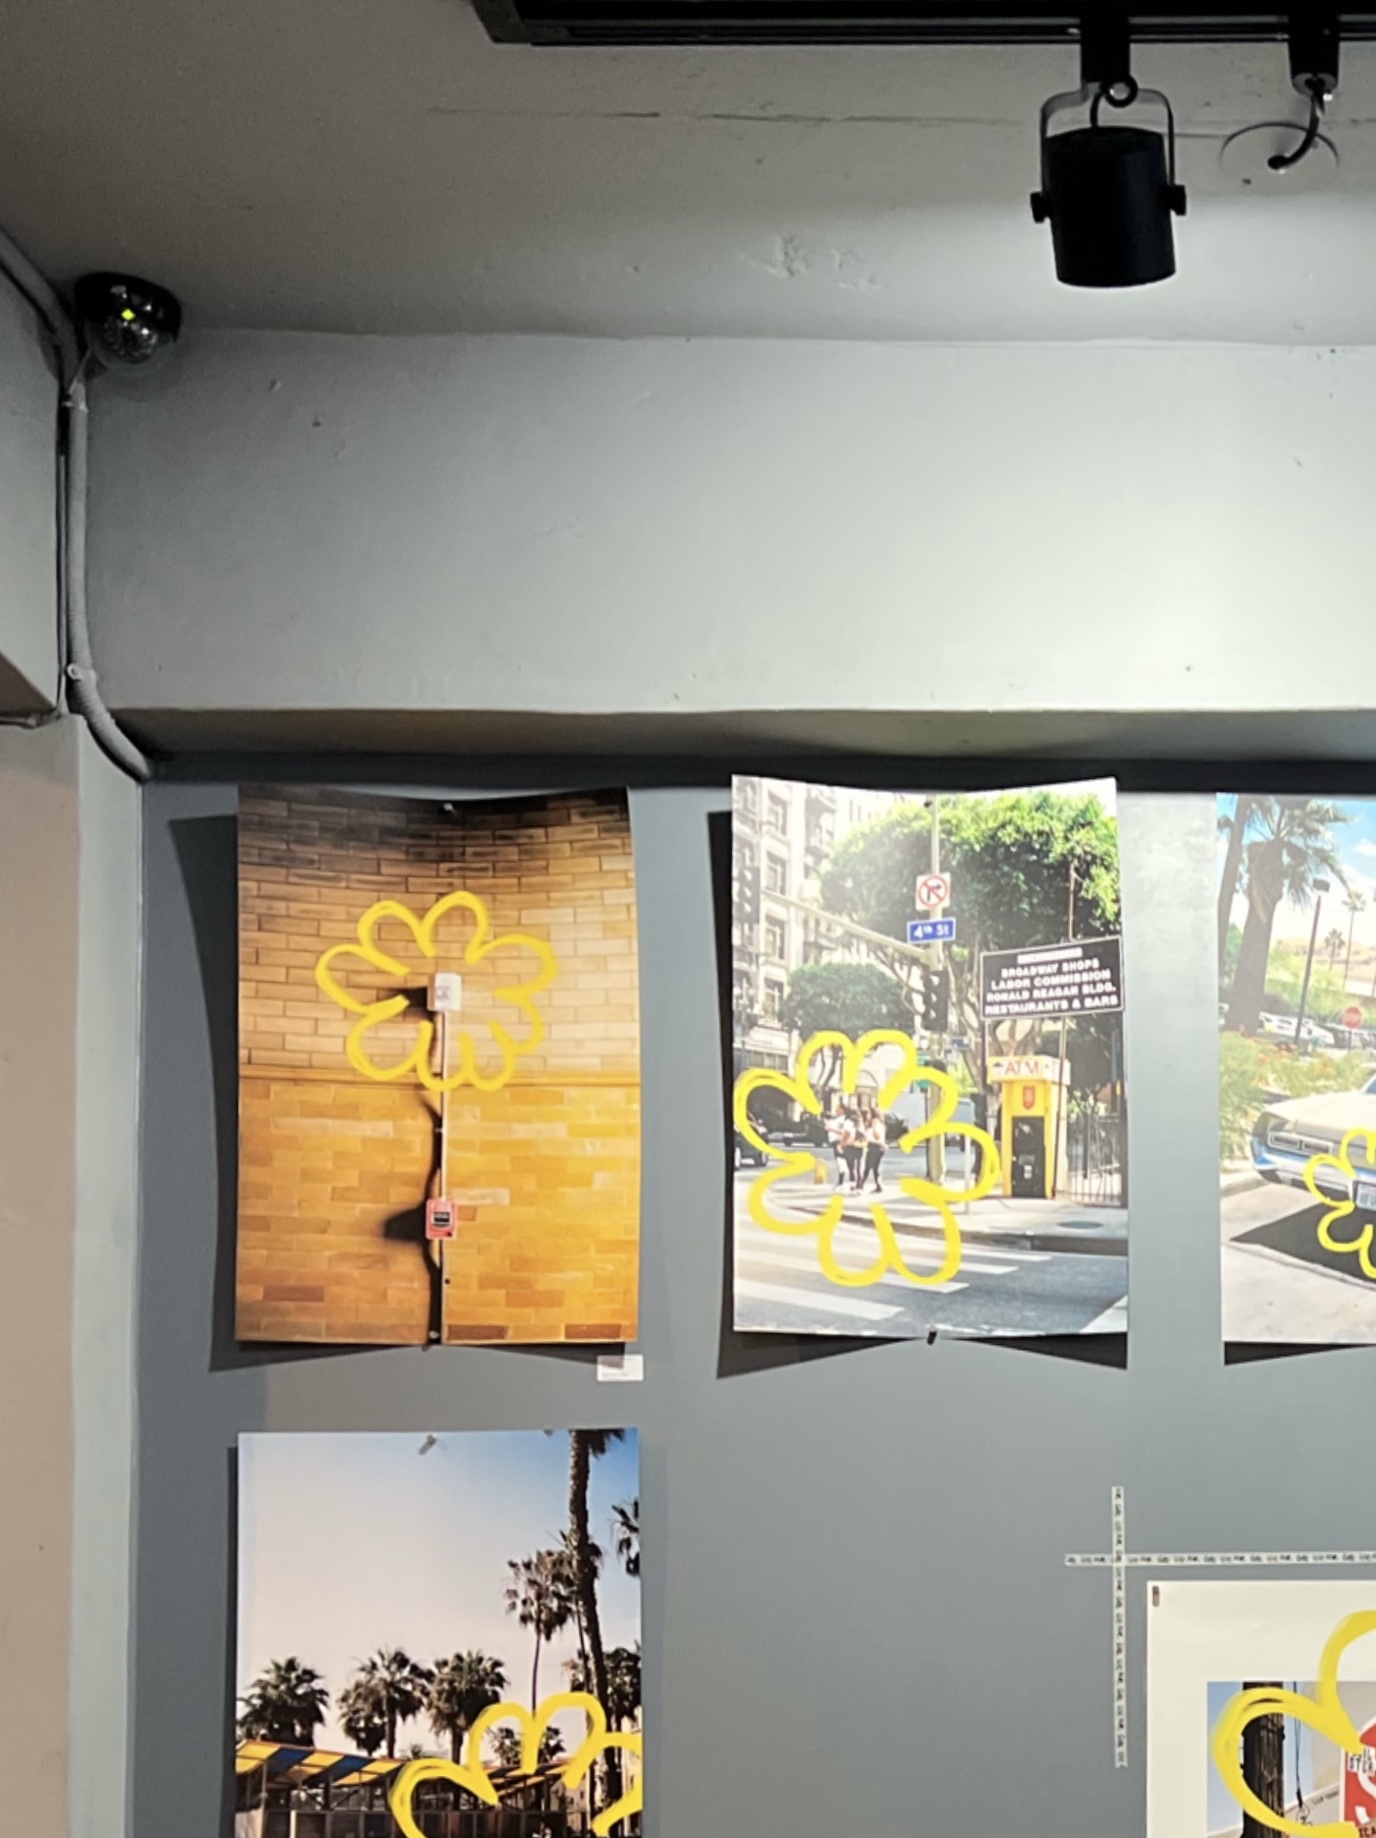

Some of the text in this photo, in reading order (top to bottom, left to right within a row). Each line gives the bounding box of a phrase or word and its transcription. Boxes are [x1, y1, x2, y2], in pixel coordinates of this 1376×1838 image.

[1001, 957, 1100, 978] BROADWAY SHOPS
[991, 969, 1112, 991] LABOR COMMISSION
[986, 989, 1030, 1003] RONALD
[1032, 986, 1079, 999] REAGAN
[985, 1000, 1069, 1015] RESTAURANTS
[1084, 995, 1119, 1008] BARS
[1005, 1061, 1039, 1075] ATM
